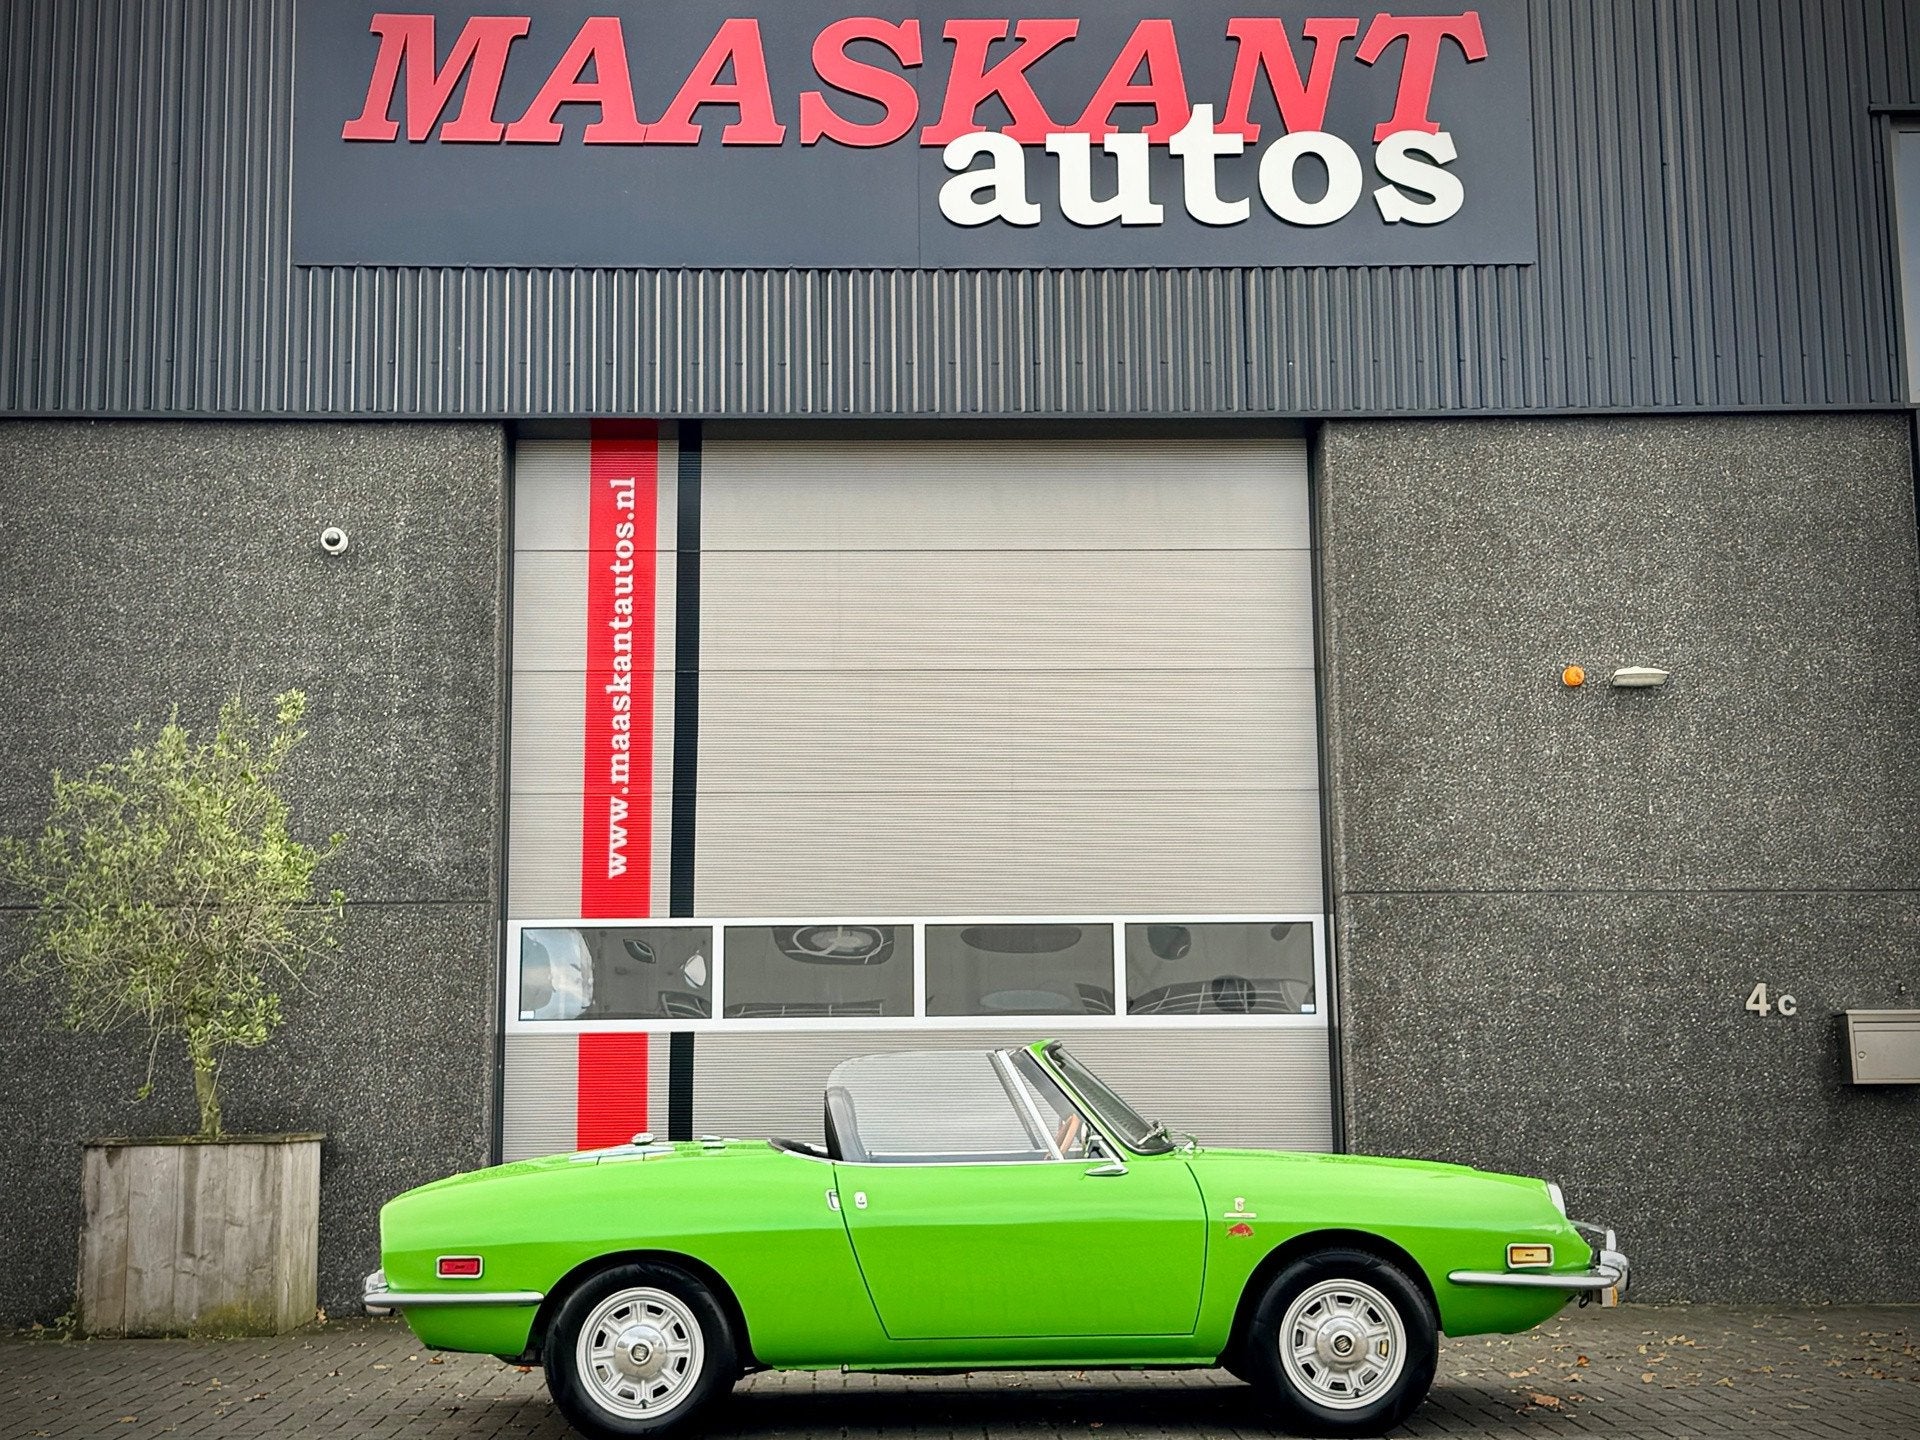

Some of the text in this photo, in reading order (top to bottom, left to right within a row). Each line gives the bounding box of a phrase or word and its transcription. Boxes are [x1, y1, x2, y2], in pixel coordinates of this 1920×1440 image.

[342, 11, 1488, 147] MAASKANT
[939, 103, 1464, 227] autos
[605, 476, 636, 879] www.maaskantautos.nl
